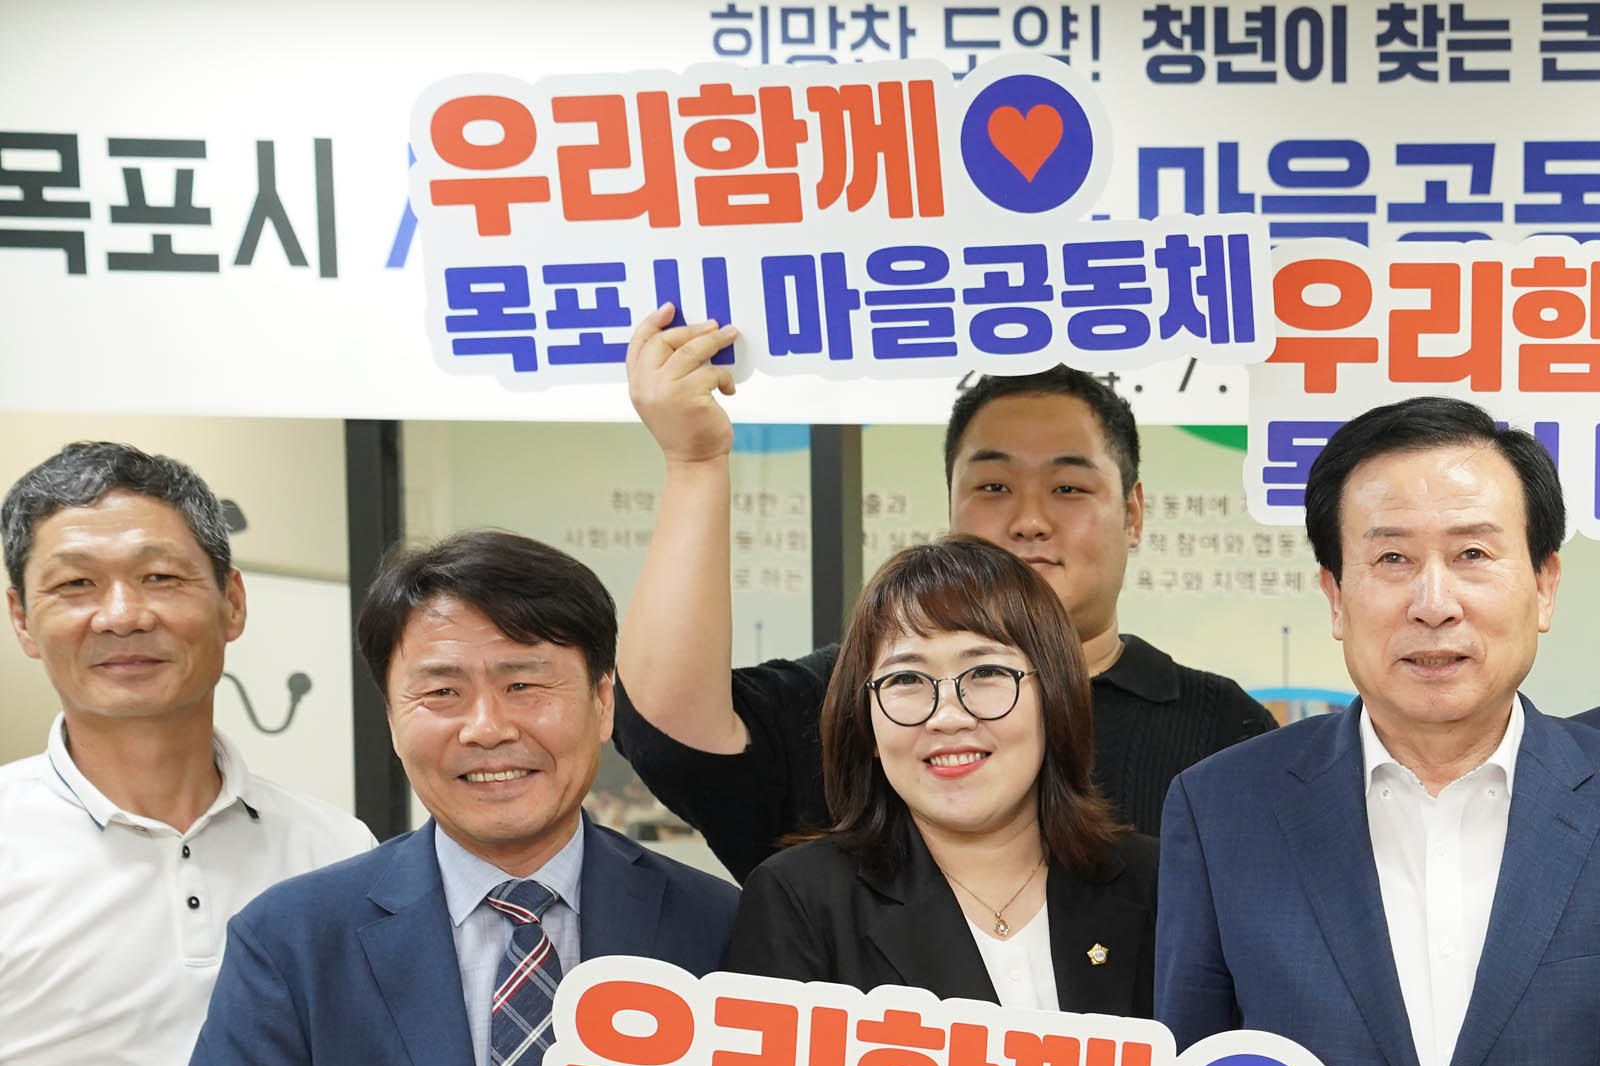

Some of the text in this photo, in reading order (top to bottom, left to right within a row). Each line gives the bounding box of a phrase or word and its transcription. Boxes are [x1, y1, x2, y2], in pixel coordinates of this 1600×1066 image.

[1142, 4, 1348, 84] 청년이
[1376, 2, 1512, 84] 찾는
[0, 132, 338, 278] 목포시
[429, 80, 945, 236] 우리함께
[444, 234, 1256, 373] 목포시 마을공동체
